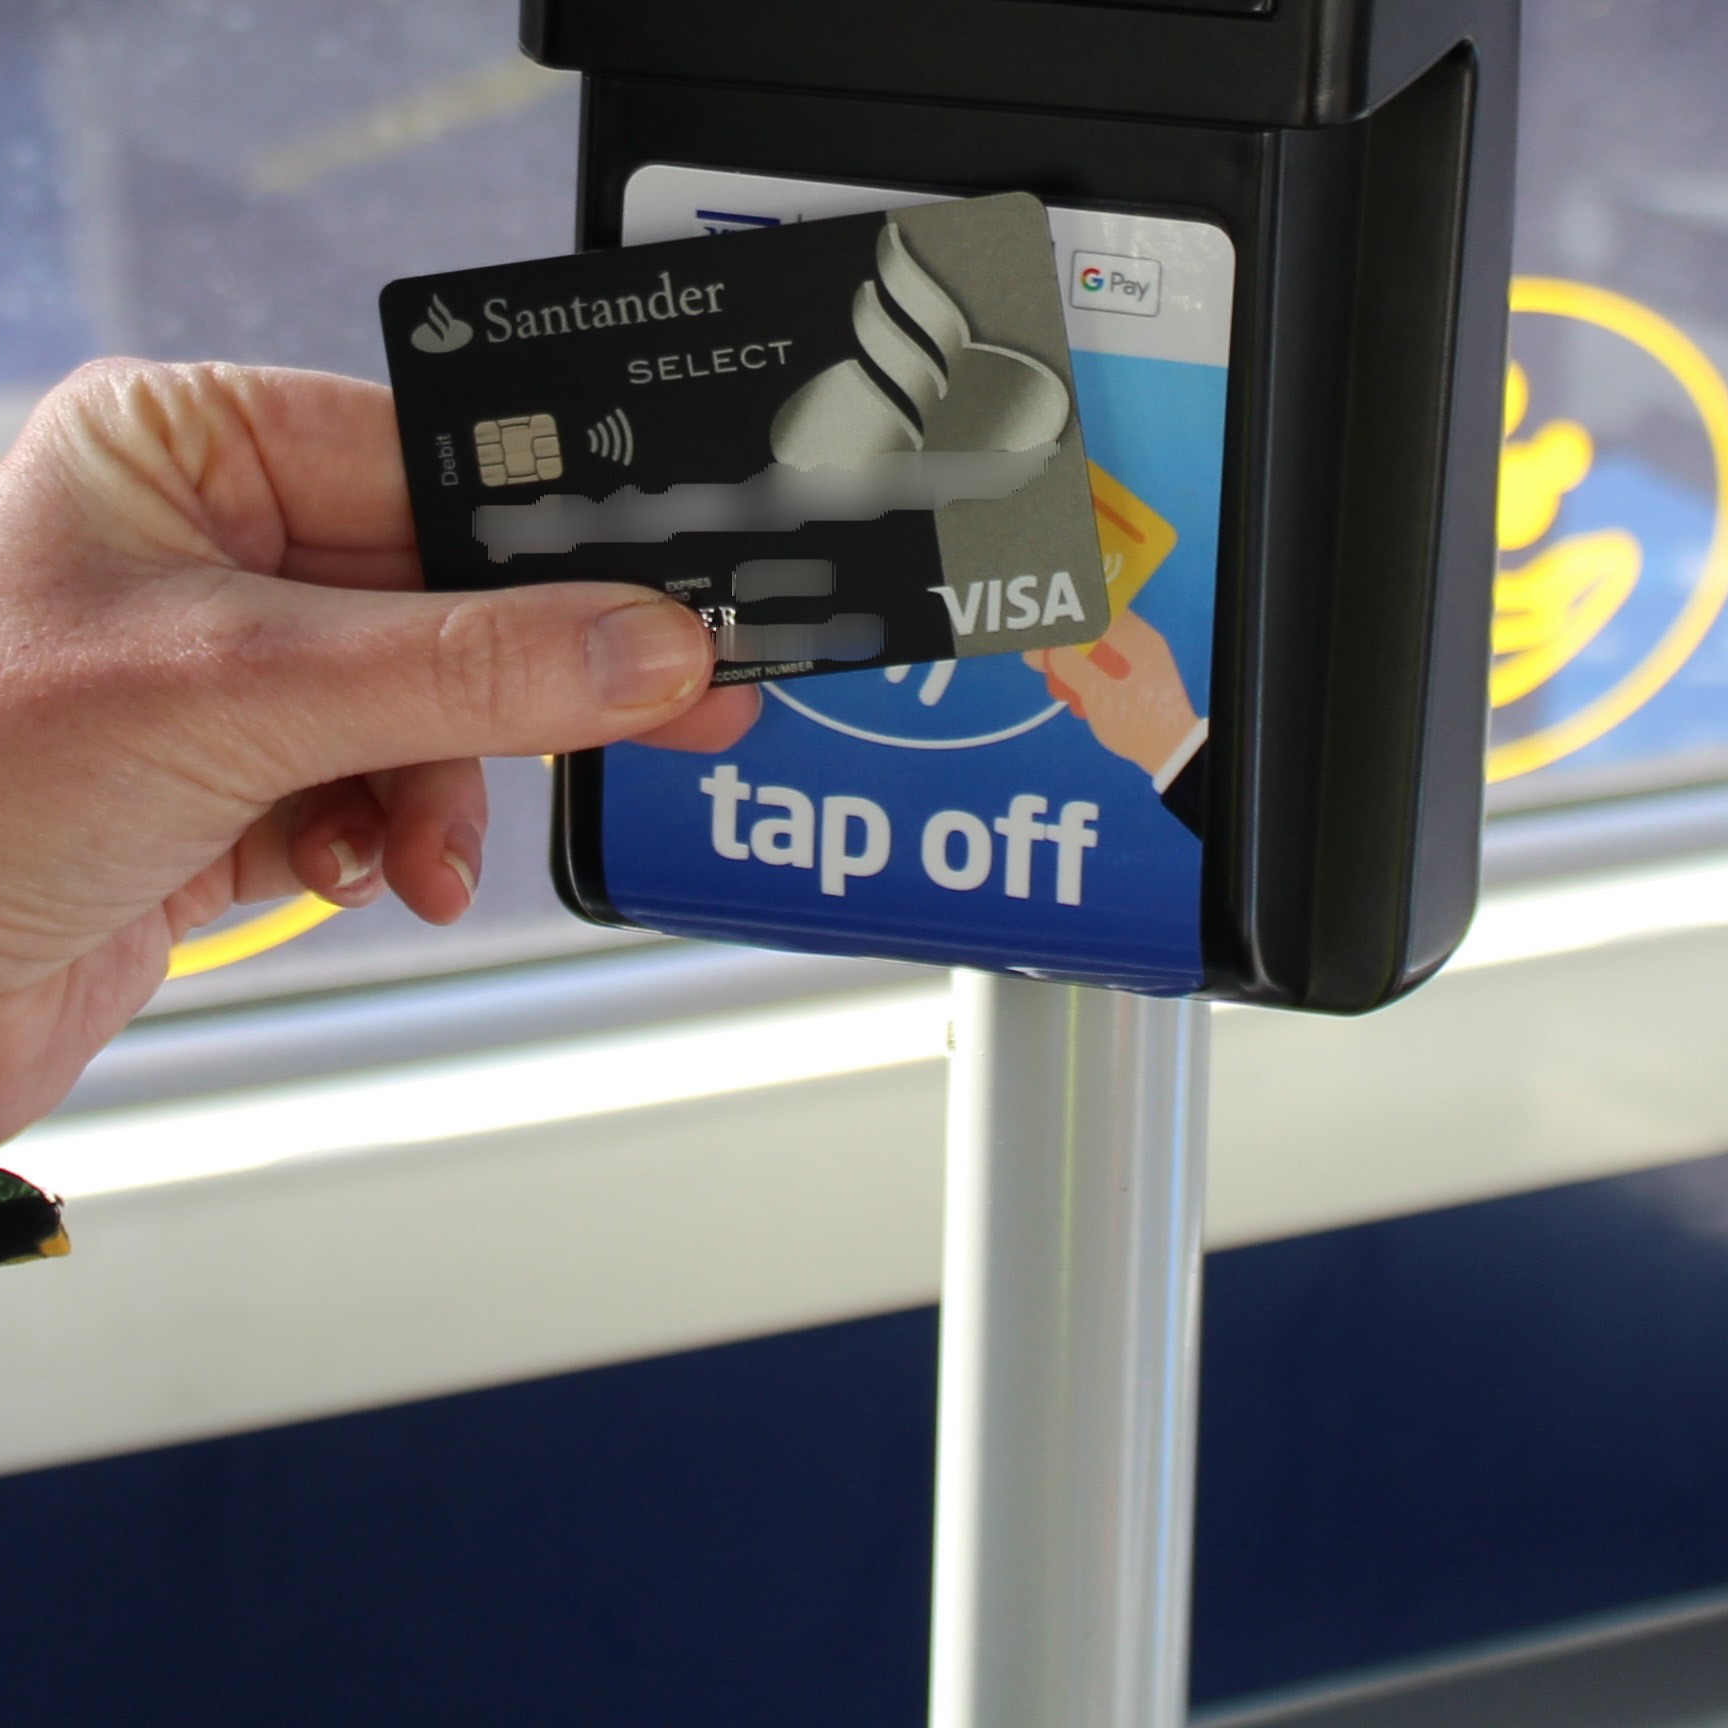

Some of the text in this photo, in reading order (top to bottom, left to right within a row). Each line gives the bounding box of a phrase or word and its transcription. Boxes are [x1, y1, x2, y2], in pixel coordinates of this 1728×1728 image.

[483, 271, 725, 343] Santander
[1110, 271, 1150, 302] Pay
[627, 340, 793, 384] SELECT
[435, 434, 459, 486] Debit
[926, 571, 1086, 637] VISA
[715, 660, 814, 683] CCOUNT NUMBER
[700, 765, 1100, 906] tap off
